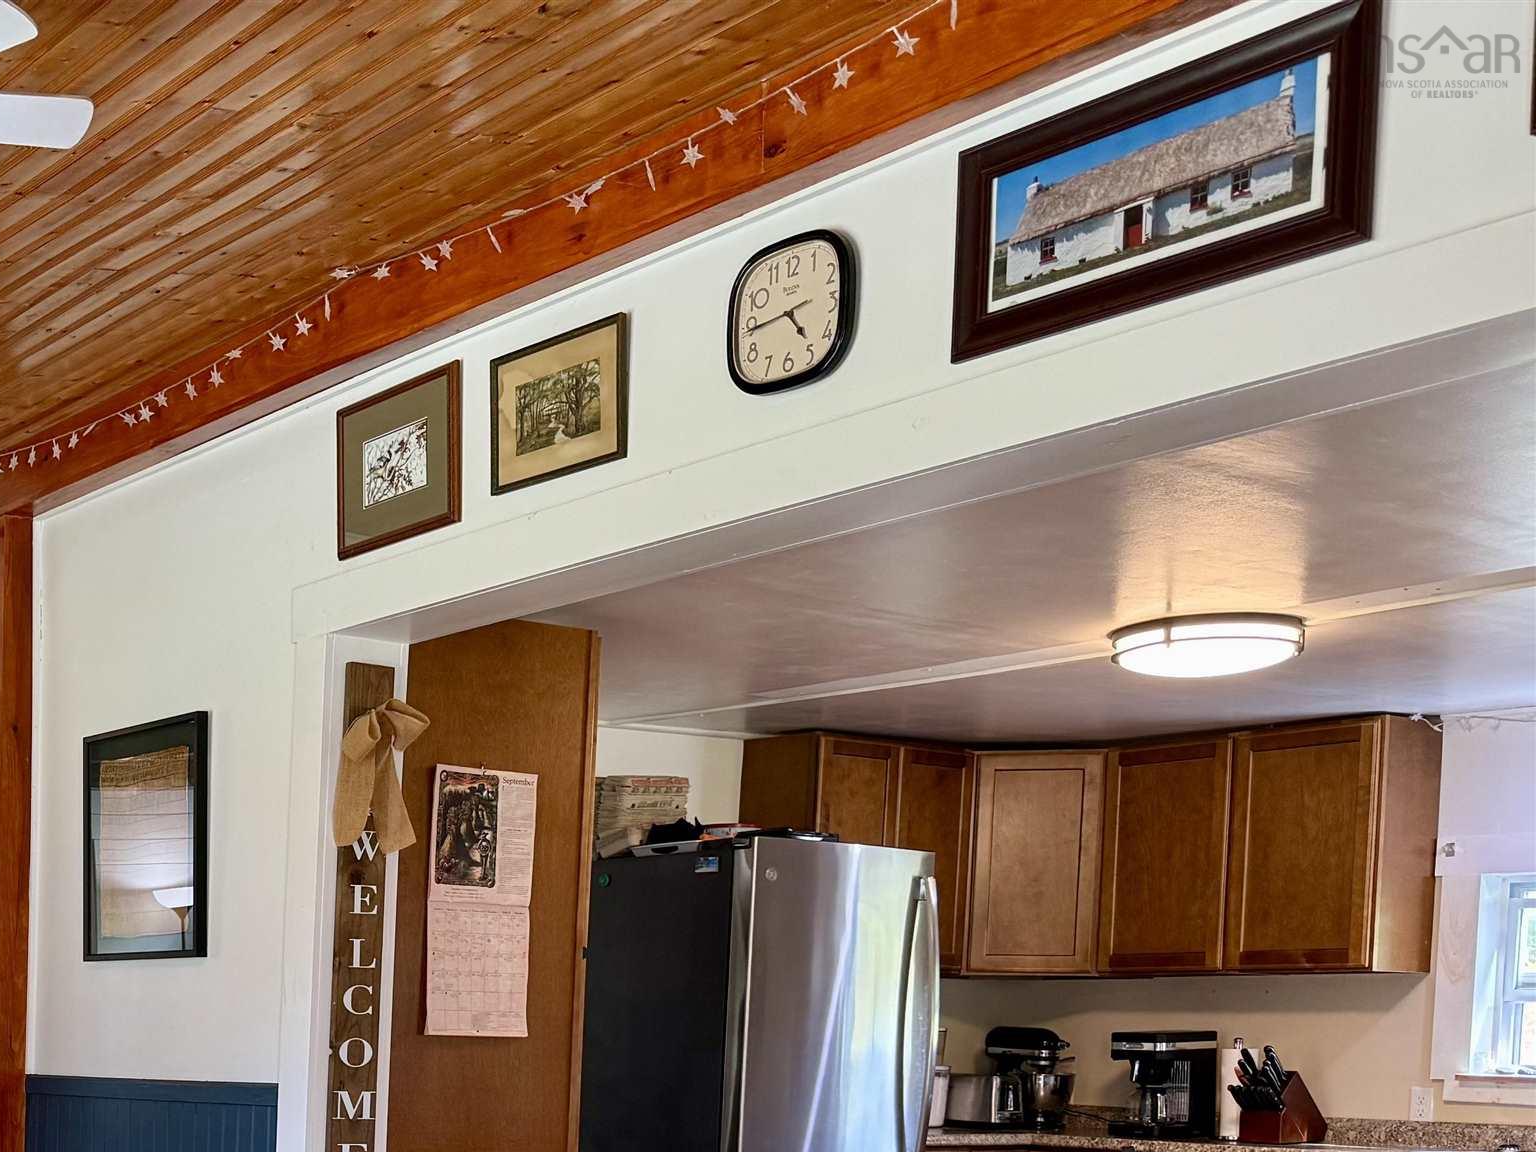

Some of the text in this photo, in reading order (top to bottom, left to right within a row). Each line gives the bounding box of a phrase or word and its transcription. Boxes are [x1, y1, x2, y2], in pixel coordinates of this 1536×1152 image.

[785, 254, 801, 278] 12
[810, 249, 817, 272] 1
[767, 262, 780, 286] 11
[825, 262, 836, 285] 2
[748, 287, 770, 312] 10
[828, 290, 838, 314] 3
[746, 316, 758, 337] 9
[821, 319, 833, 341] 4
[746, 342, 759, 363] 8
[782, 351, 795, 373] 6
[805, 343, 814, 366] 5
[764, 354, 773, 378] 7
[502, 776, 535, 787] September
